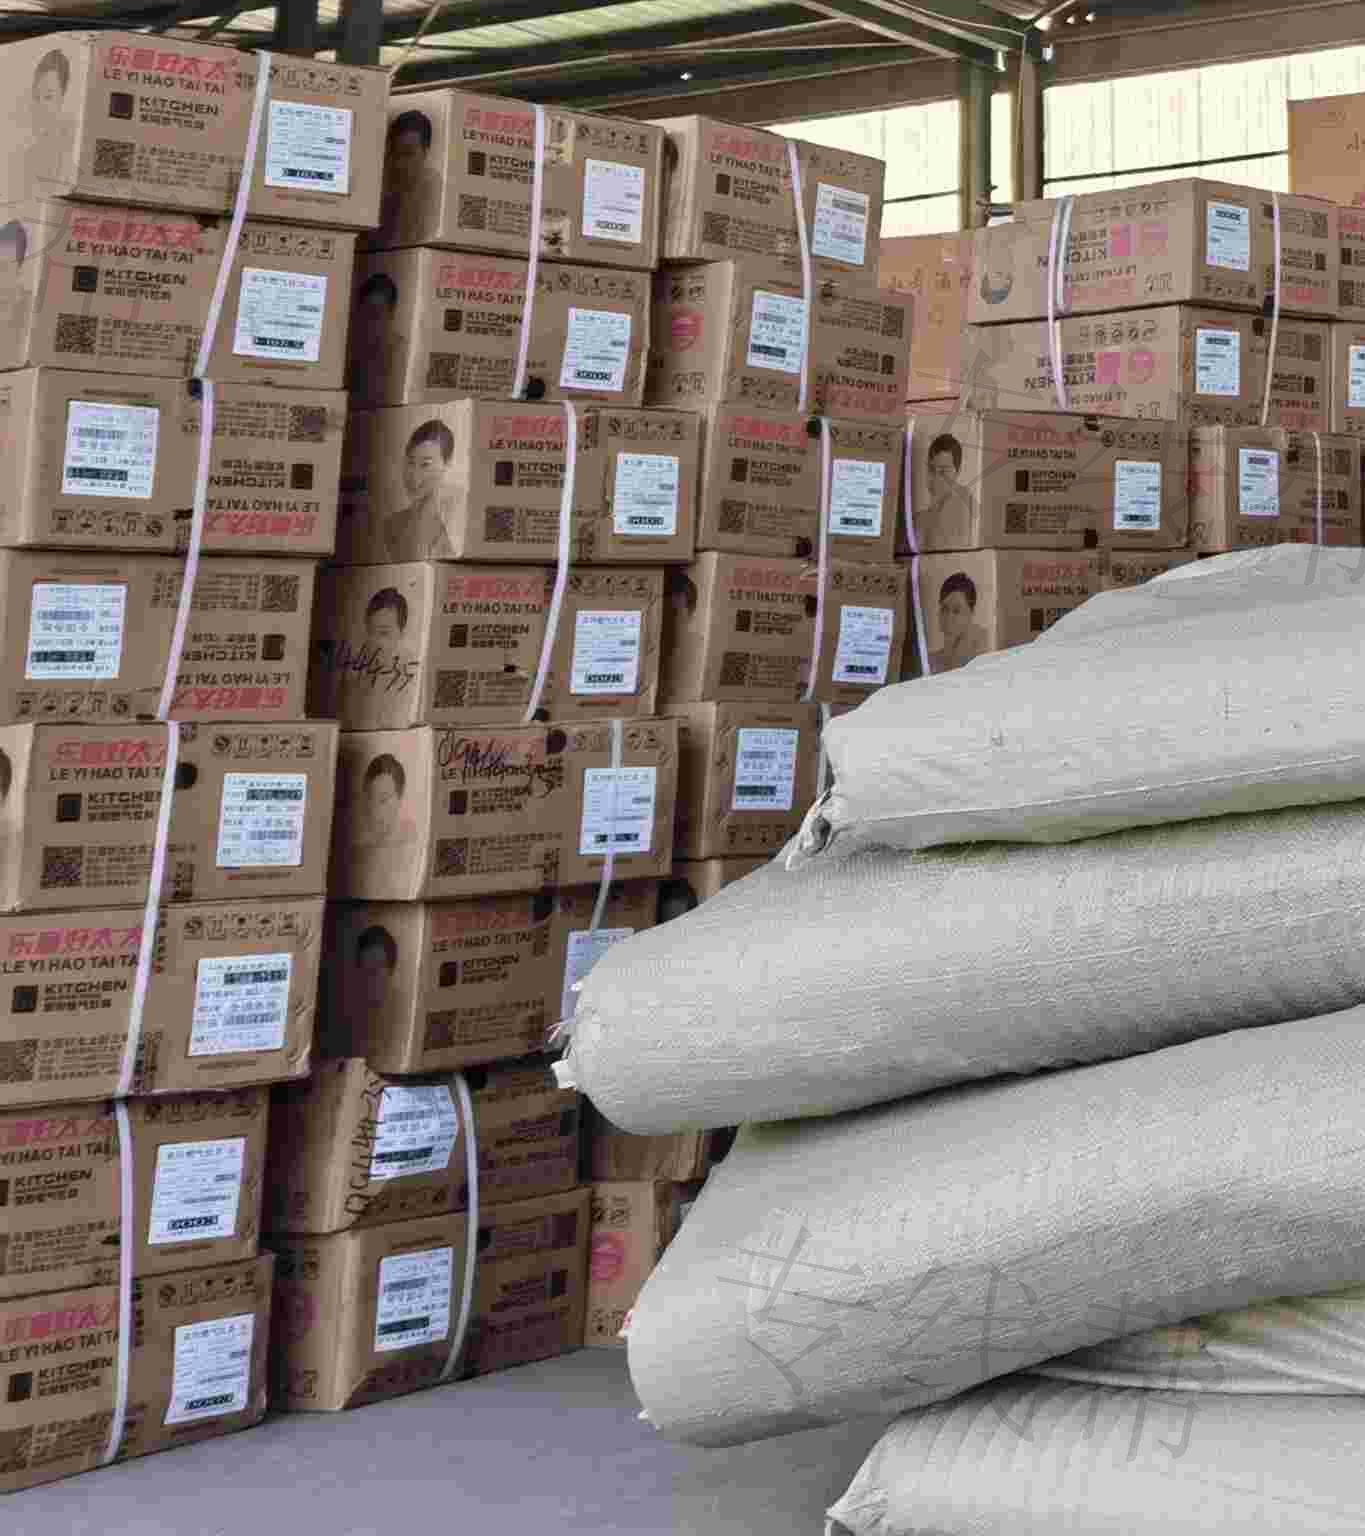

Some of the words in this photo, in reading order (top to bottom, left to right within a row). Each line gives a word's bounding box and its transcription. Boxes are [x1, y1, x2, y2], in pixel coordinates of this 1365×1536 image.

[104, 66, 120, 80] LE
[127, 70, 139, 84] YI
[143, 72, 174, 89] HAO
[178, 77, 200, 93] TAI
[204, 81, 224, 96] TAI
[139, 96, 218, 116] KITCHEN
[66, 240, 87, 254] LE
[90, 242, 106, 257] YI
[109, 245, 141, 260] HAO
[143, 248, 167, 262] TAI
[168, 251, 192, 265] TAI
[104, 268, 187, 287] KITCHEN
[471, 623, 529, 635] KITCHEN
[50, 767, 69, 781] LE
[73, 767, 87, 781] YI
[90, 767, 122, 781] HAO
[128, 767, 150, 780] TAI
[3, 959, 25, 974] LE
[30, 959, 45, 973] YI
[48, 958, 85, 972] HAO
[92, 956, 115, 969] TAI
[44, 979, 127, 994] KITCHEN
[15, 1168, 93, 1187] KITCHEN
[40, 1357, 112, 1379] KITCHEN
